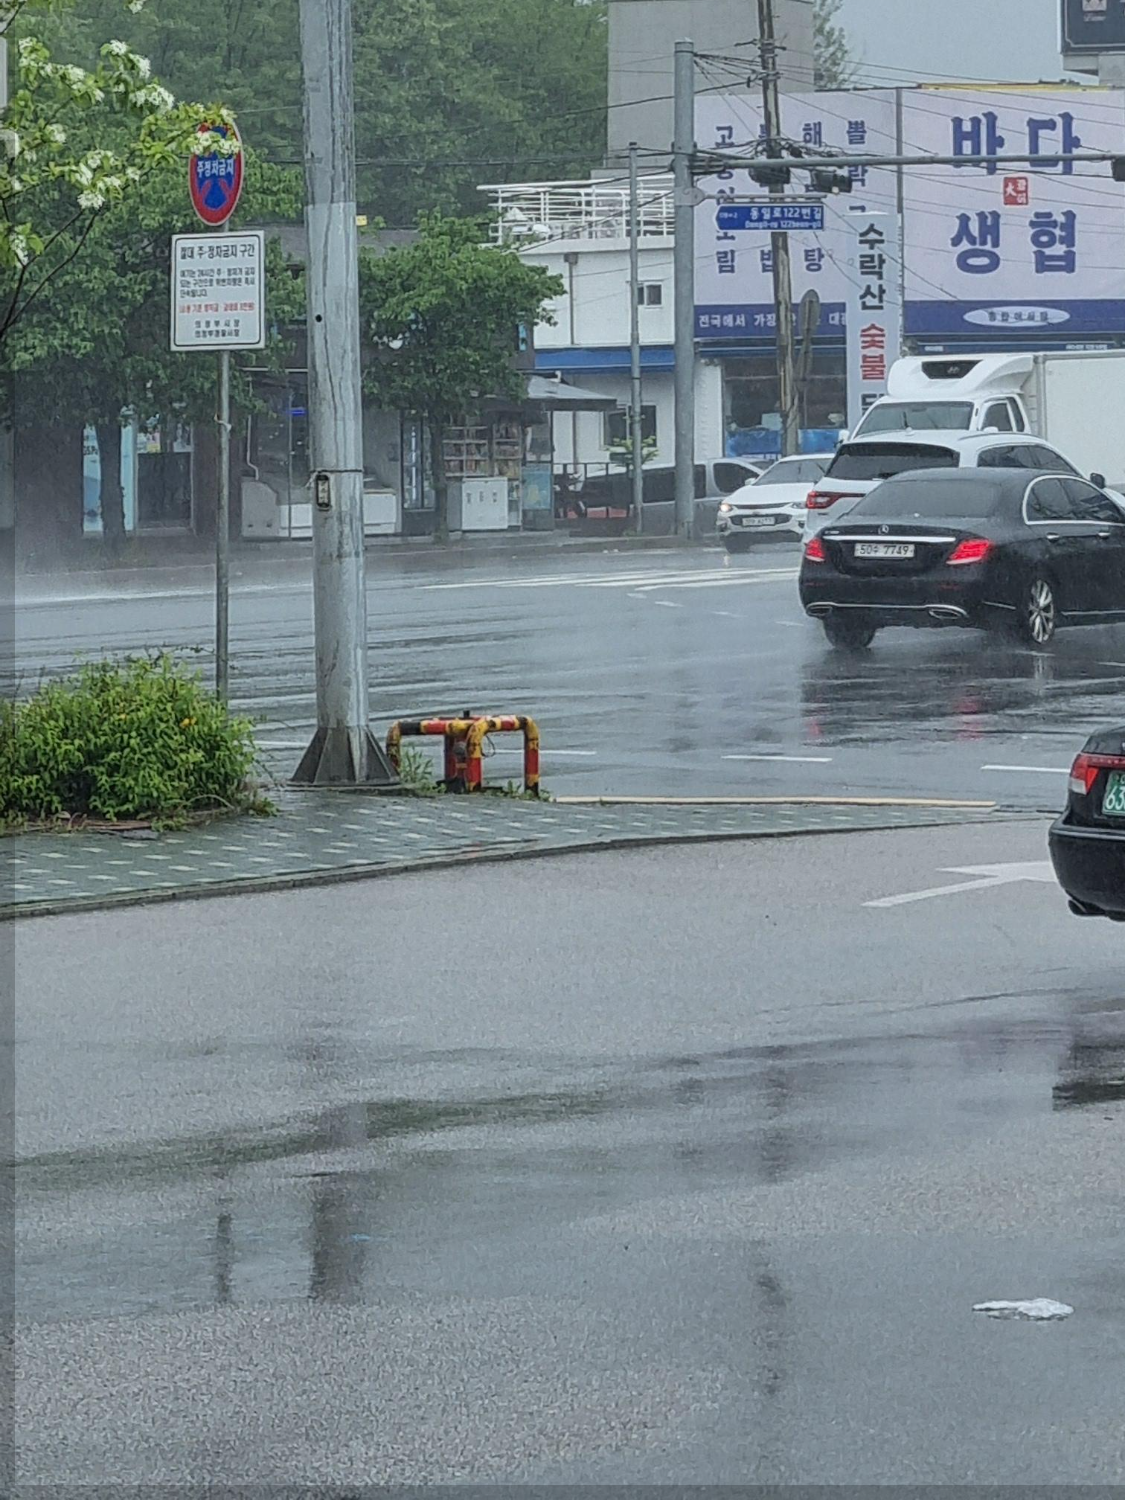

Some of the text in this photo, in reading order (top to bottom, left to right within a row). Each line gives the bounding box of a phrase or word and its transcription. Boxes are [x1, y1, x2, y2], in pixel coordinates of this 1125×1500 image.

[197, 159, 234, 178] 주정차금지
[951, 111, 1081, 175] 바다
[240, 244, 255, 258] 구간
[858, 222, 886, 311] 수락산
[950, 210, 1077, 274] 생협
[859, 323, 886, 380] 숯불
